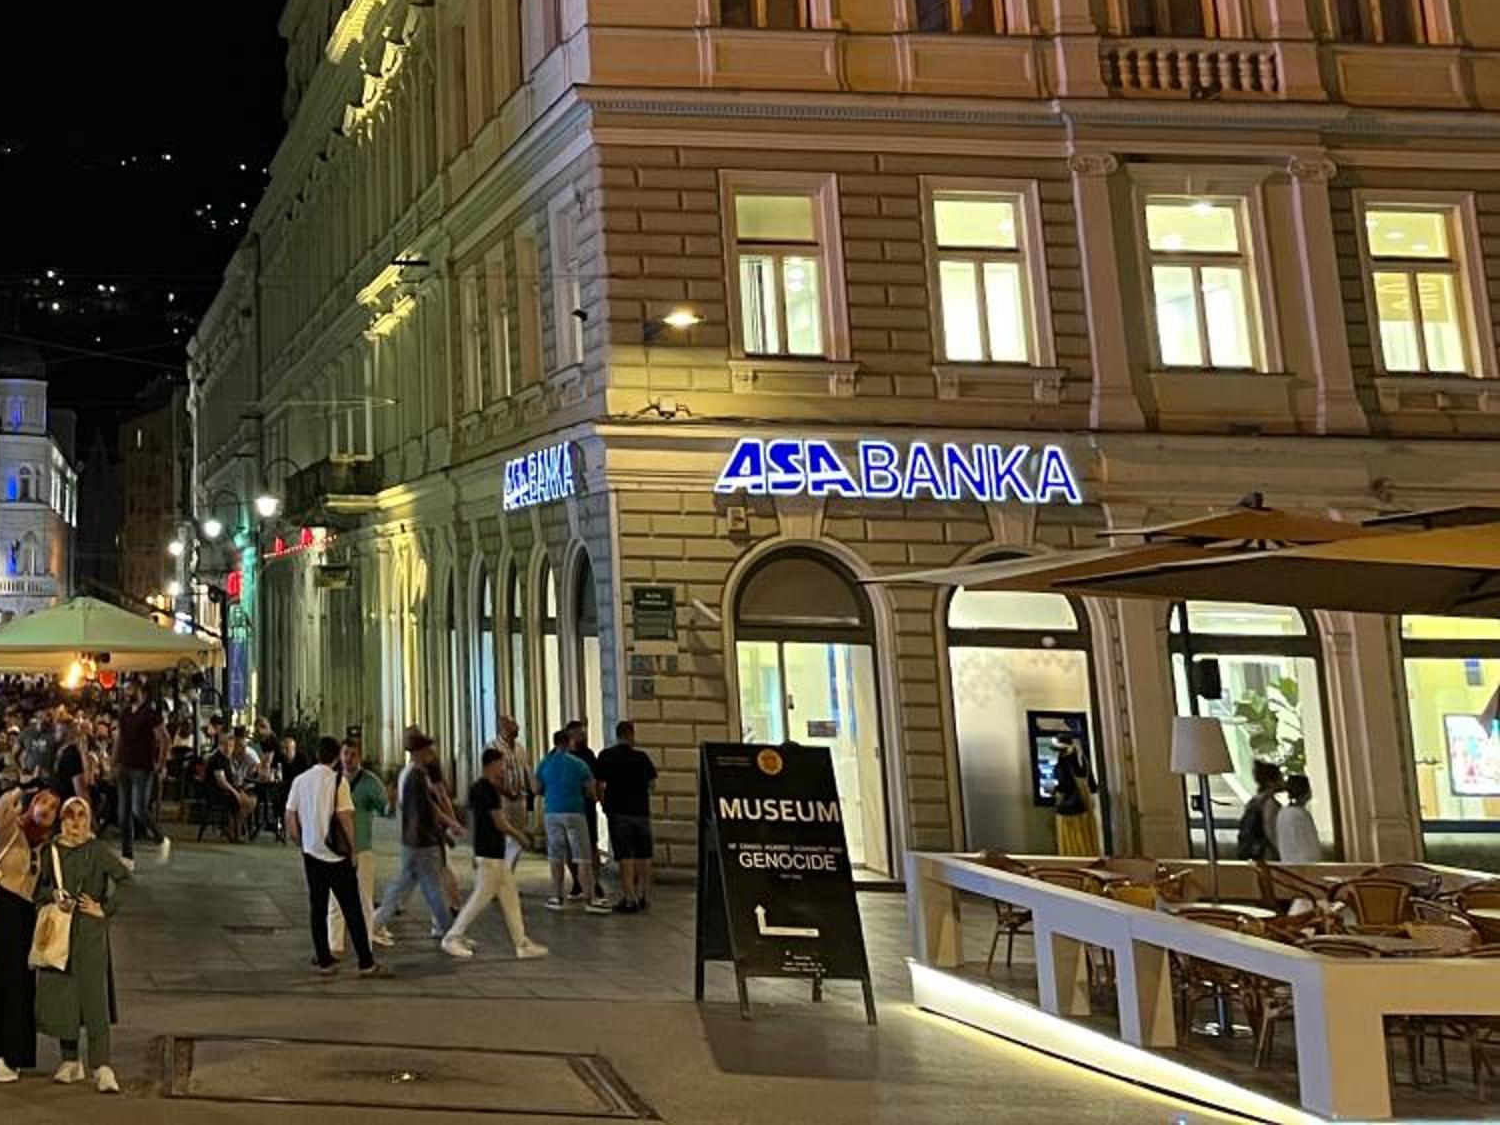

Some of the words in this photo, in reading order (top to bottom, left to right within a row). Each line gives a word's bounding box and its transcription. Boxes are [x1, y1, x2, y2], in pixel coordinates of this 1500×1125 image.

[713, 438, 861, 497] ASA
[858, 440, 1082, 505] BANKA
[718, 797, 840, 823] MUSEUM
[738, 852, 837, 871] GENOCIDE
